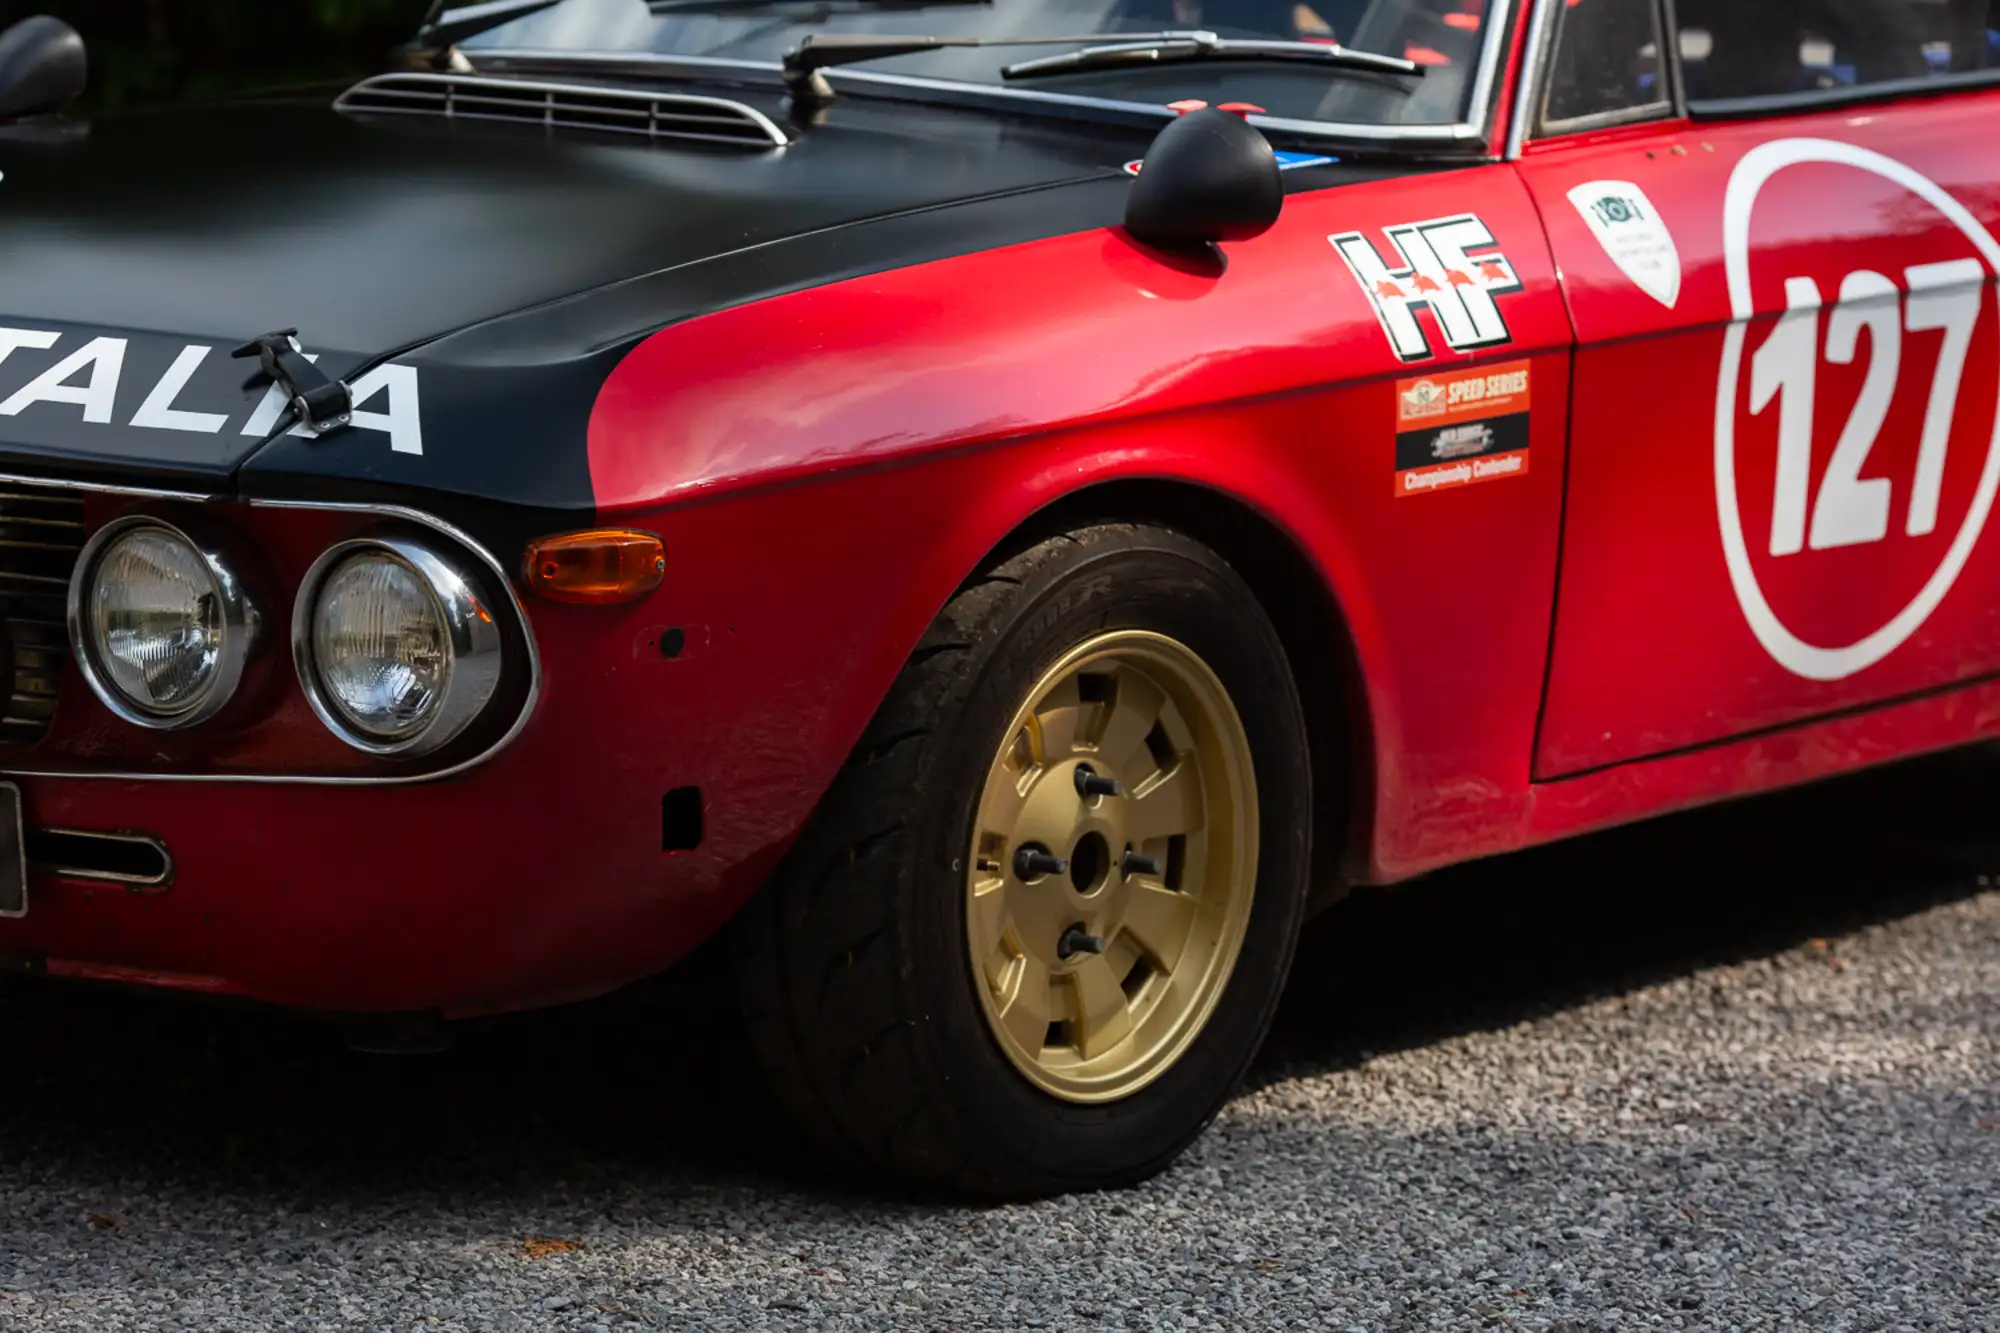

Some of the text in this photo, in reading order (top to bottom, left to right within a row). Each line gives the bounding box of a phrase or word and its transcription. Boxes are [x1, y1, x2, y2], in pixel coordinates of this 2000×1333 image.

[1327, 213, 1524, 363] HF
[1448, 378, 1485, 404] SPEED
[1485, 370, 1528, 397] SERIES
[1749, 258, 1985, 556] 127
